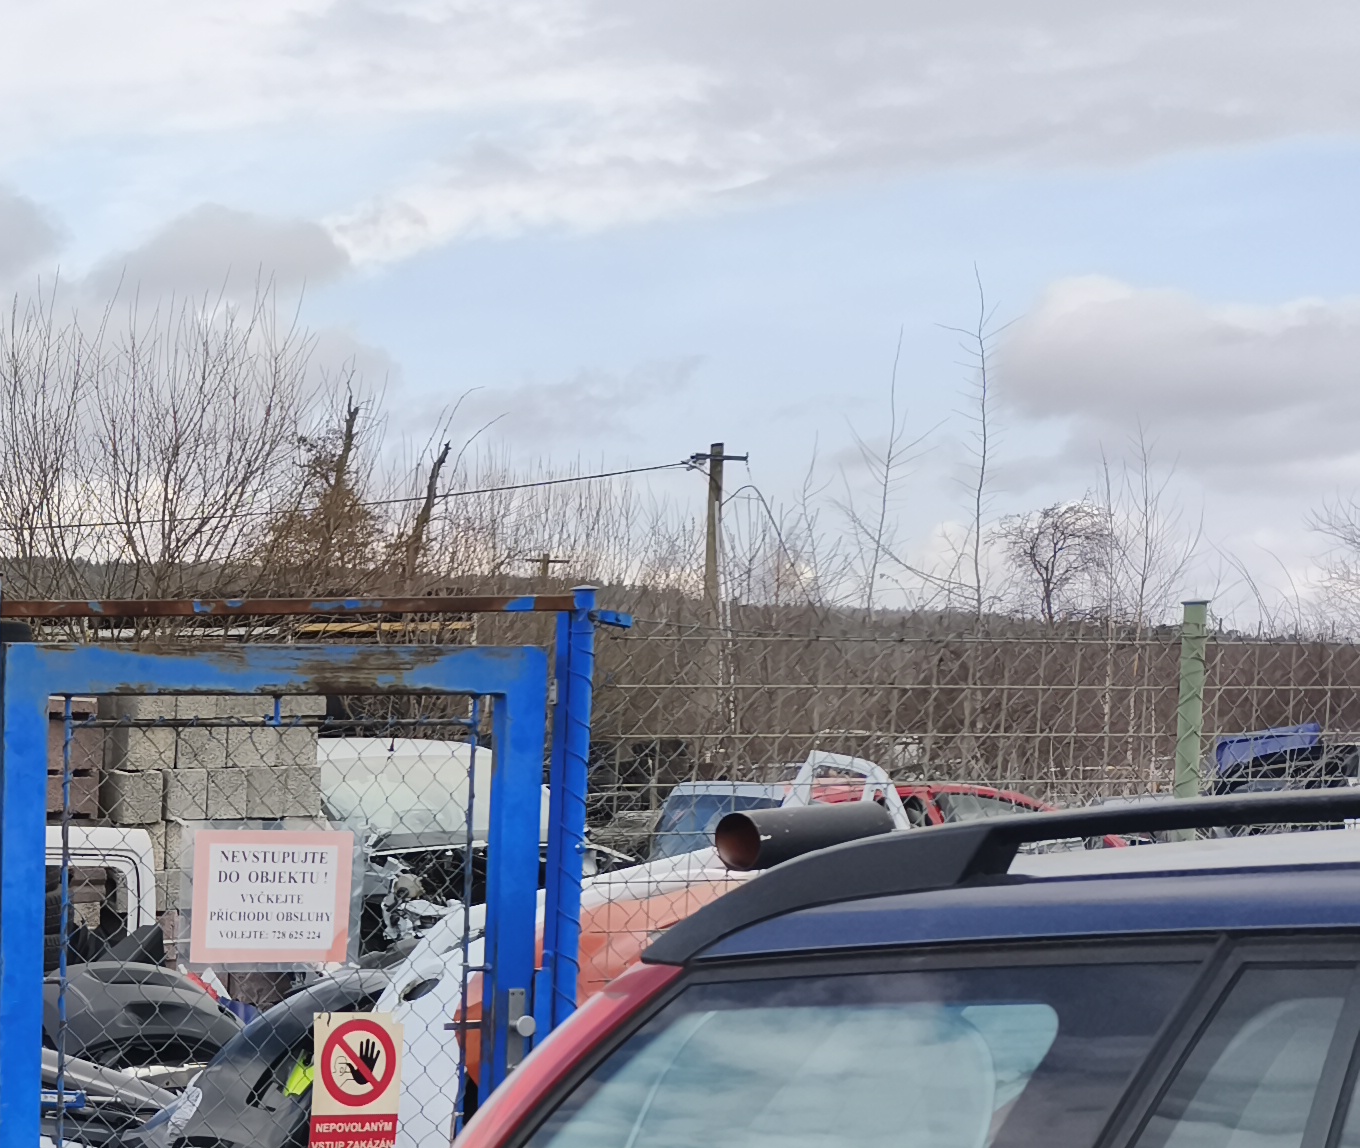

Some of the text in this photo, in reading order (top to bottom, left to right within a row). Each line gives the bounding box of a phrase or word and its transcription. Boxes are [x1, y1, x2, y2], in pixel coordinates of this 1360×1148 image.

[220, 850, 329, 865] NEVSTUPUJTE
[218, 870, 240, 883] DO
[248, 871, 318, 884] OBJEKTU
[240, 891, 304, 904] VYČKEJTE
[209, 908, 333, 922] PŘÍCHODU OBSLUHY
[219, 930, 321, 940] VOLEJTE: 728 625 224
[315, 1120, 393, 1133] NEPOVOLANÝM
